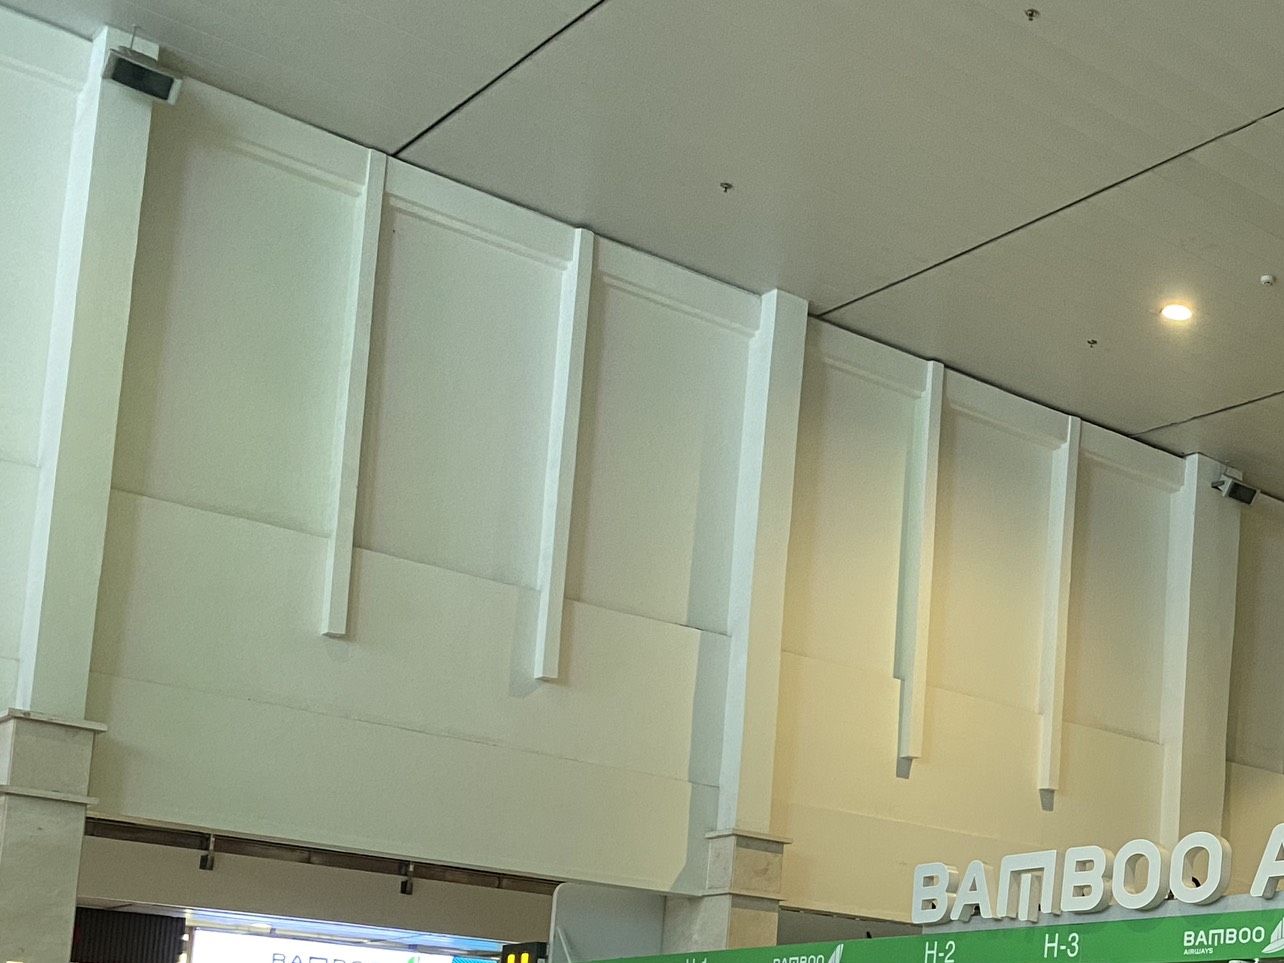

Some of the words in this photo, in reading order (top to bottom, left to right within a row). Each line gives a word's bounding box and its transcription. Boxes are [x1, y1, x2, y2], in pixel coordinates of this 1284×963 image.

[912, 831, 1231, 926] BAMBOO
[1044, 932, 1079, 959] H-3
[1183, 926, 1265, 947] BAMBOO
[924, 940, 956, 963] H-2
[1183, 947, 1214, 955] AIRWAYS
